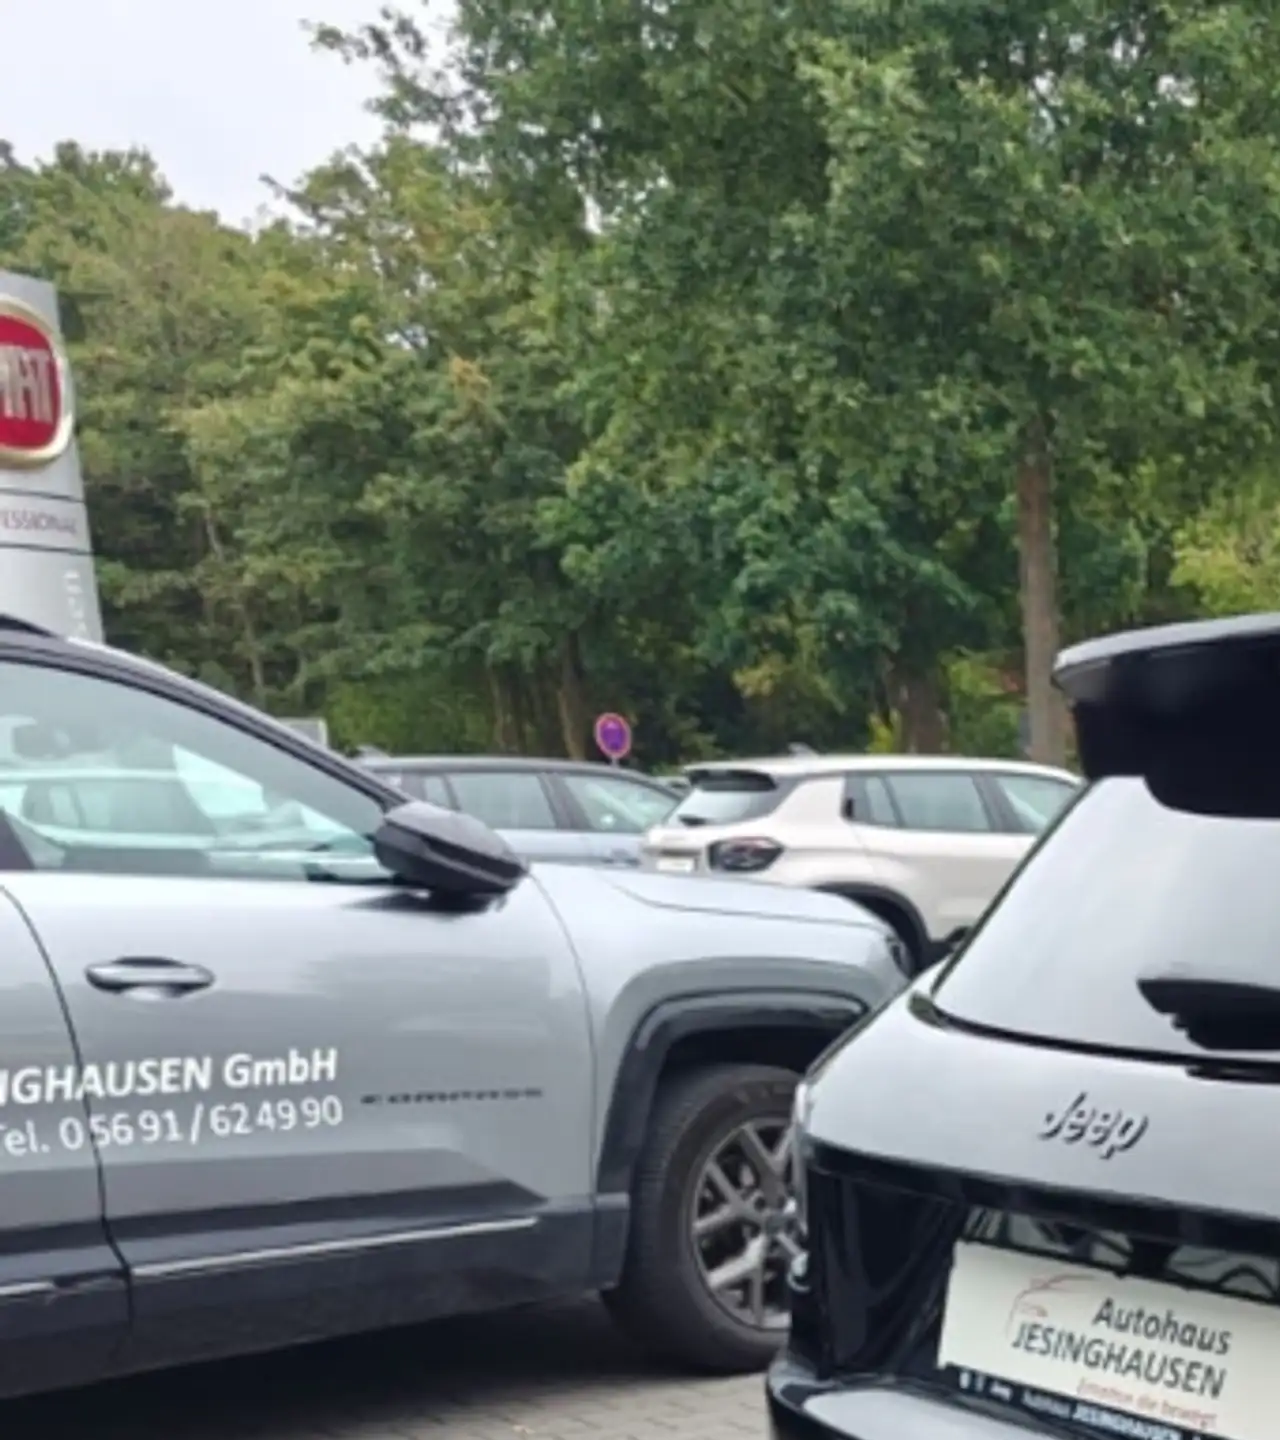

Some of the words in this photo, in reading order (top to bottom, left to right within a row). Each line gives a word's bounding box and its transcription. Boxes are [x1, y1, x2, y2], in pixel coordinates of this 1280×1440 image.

[0, 343, 53, 424] IAT
[0, 1056, 212, 1106] GHAUSEN
[223, 1047, 338, 1089] GmbH
[1038, 1091, 1149, 1160] Jeep
[1012, 1321, 1227, 1400] JESINGHAUSEN
[1092, 1297, 1232, 1356] Autohaus
